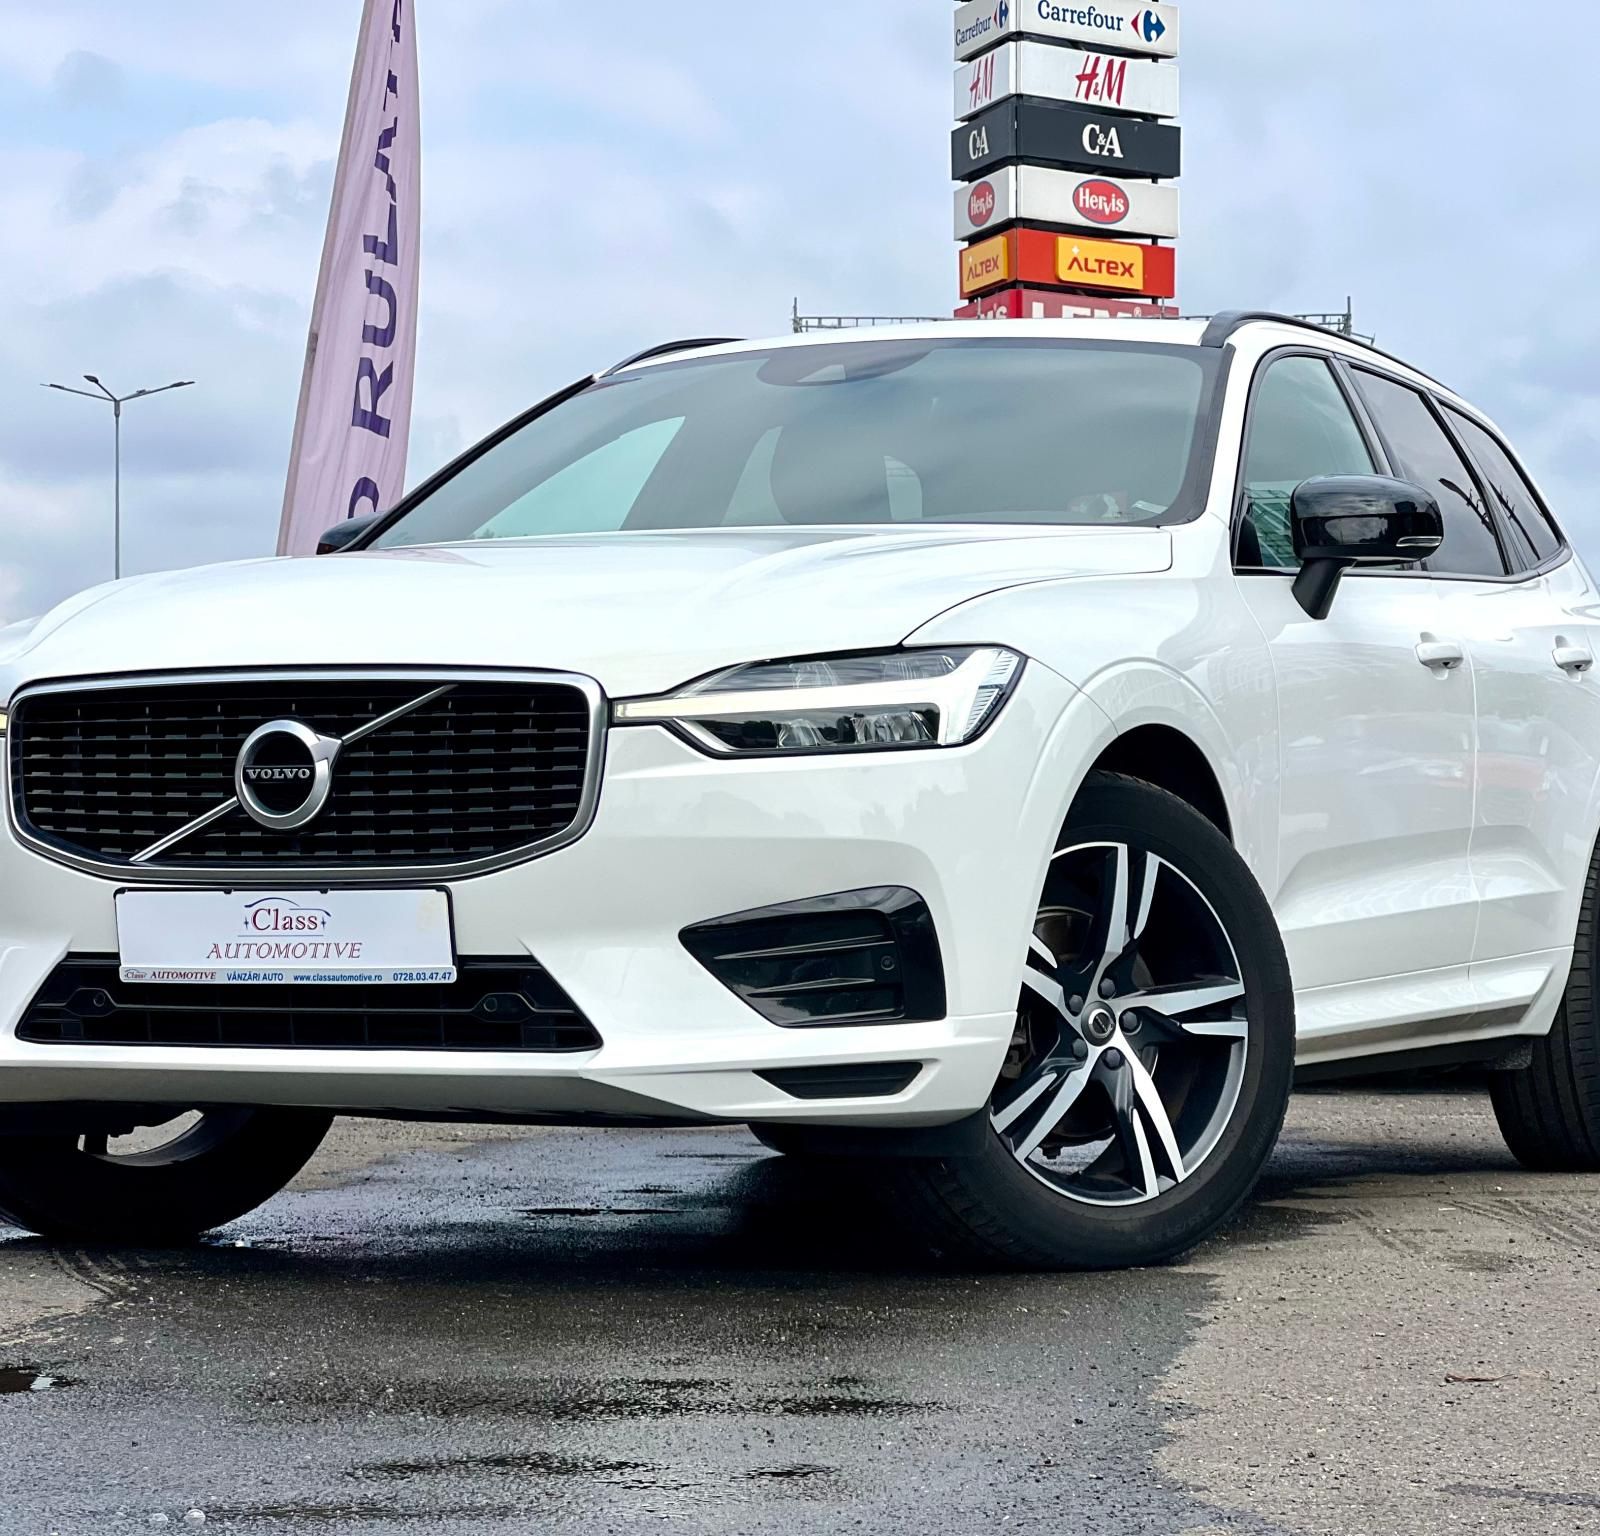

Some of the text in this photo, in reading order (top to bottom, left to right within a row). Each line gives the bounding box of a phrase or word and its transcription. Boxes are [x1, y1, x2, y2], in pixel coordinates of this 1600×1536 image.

[1038, 0, 1123, 31] Carrefour
[955, 17, 991, 46] Carrefour
[969, 51, 994, 108] H&M
[1075, 55, 1127, 106] H&M
[968, 126, 989, 160] C&A
[1082, 123, 1123, 158] C&A
[970, 191, 993, 216] Hervis
[1079, 187, 1125, 215] Hervis
[246, 768, 310, 779] VOLVO
[251, 908, 318, 931] Class
[206, 942, 363, 960] AUTOMOTIVE
[150, 971, 216, 980] AUTOMOTIVE
[262, 973, 284, 981] AUTO
[293, 973, 383, 981] www.classautomotive.ro
[392, 972, 452, 981] 0728.03.47.47
